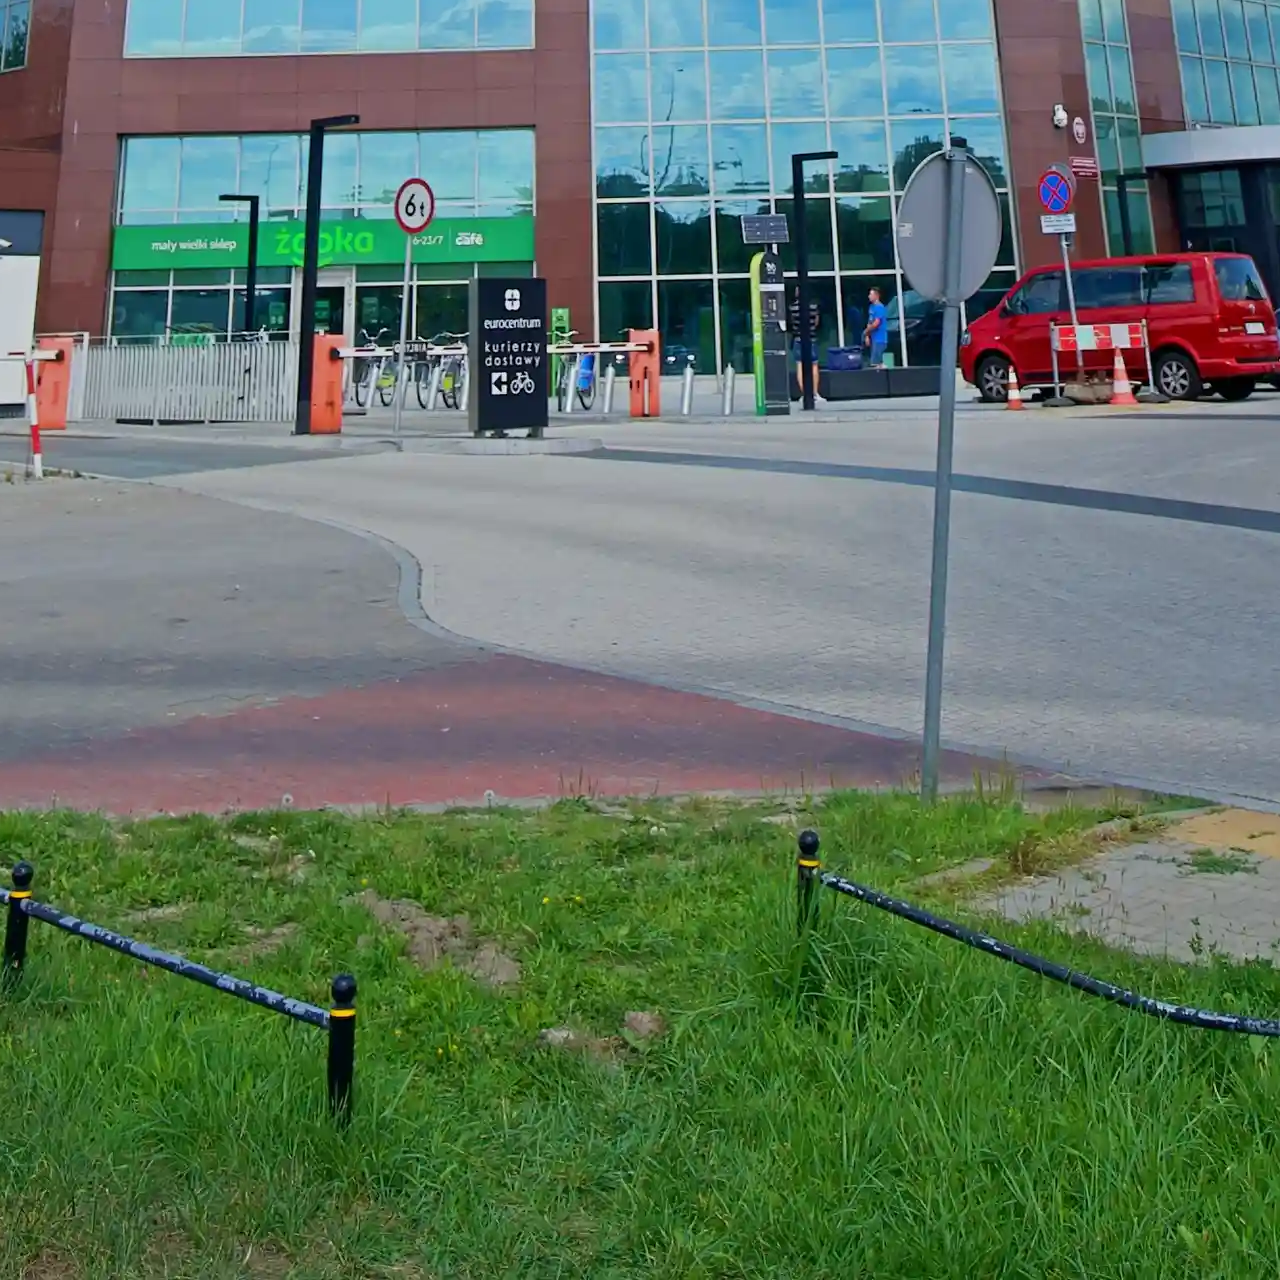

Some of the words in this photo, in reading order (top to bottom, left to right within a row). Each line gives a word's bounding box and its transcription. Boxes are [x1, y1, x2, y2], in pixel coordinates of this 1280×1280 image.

[405, 193, 417, 217] 6
[419, 201, 425, 217] t
[209, 237, 237, 252] sklep
[483, 317, 542, 329] eurocentrum
[484, 341, 541, 354] kurierzy
[484, 355, 541, 367] dostawy
